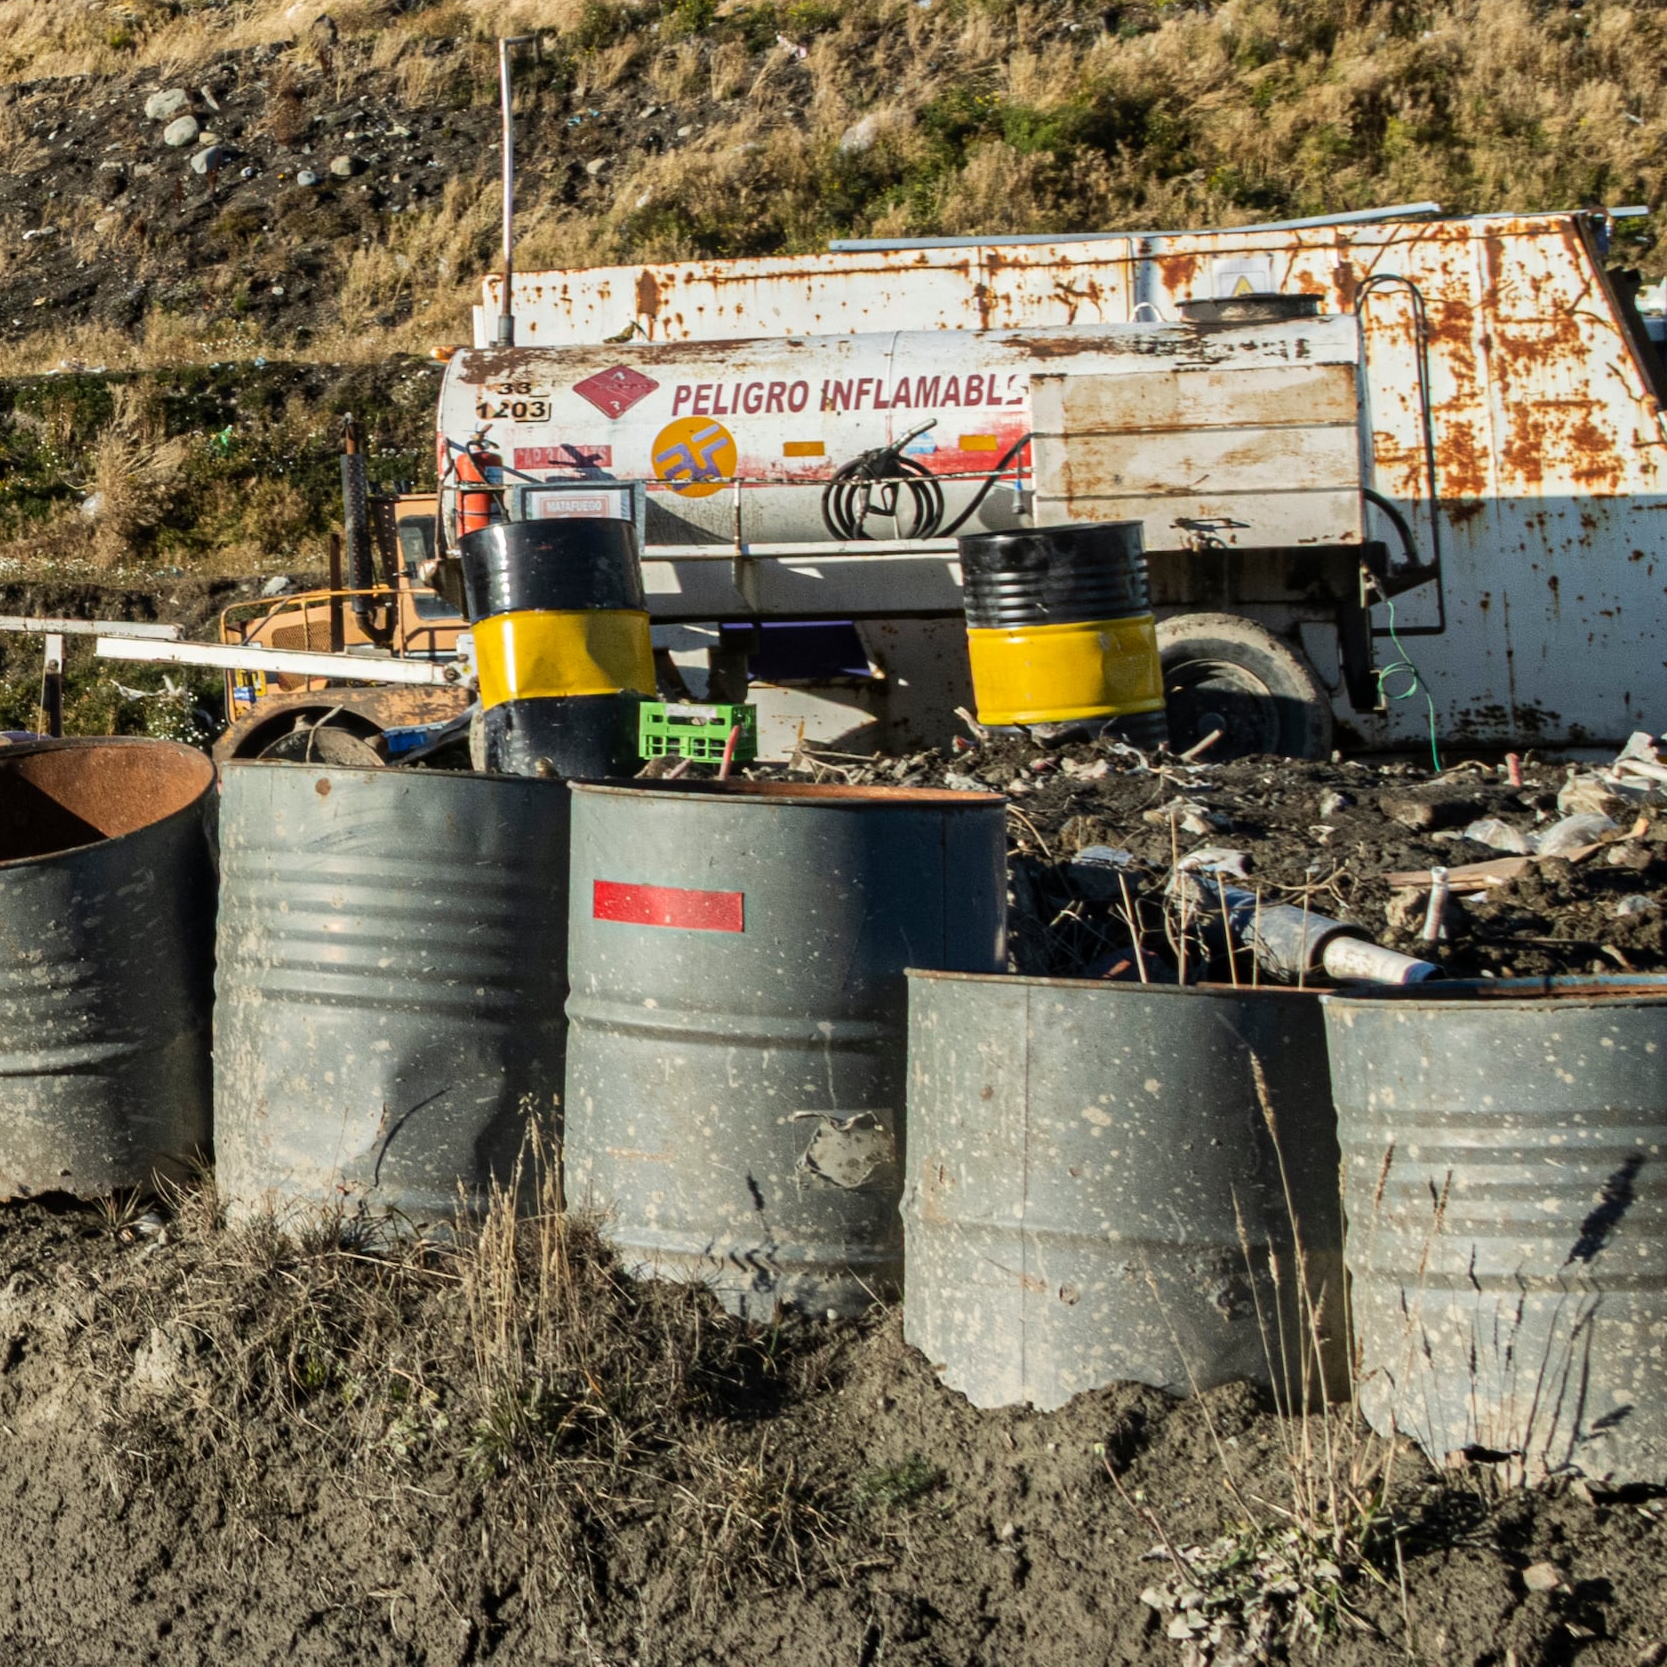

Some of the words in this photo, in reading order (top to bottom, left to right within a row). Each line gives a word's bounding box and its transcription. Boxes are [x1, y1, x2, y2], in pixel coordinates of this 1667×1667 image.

[497, 382, 532, 395] 33
[671, 380, 810, 416] PELIGRO
[475, 401, 546, 419] 1203
[546, 500, 603, 512] MATAFUEGO
